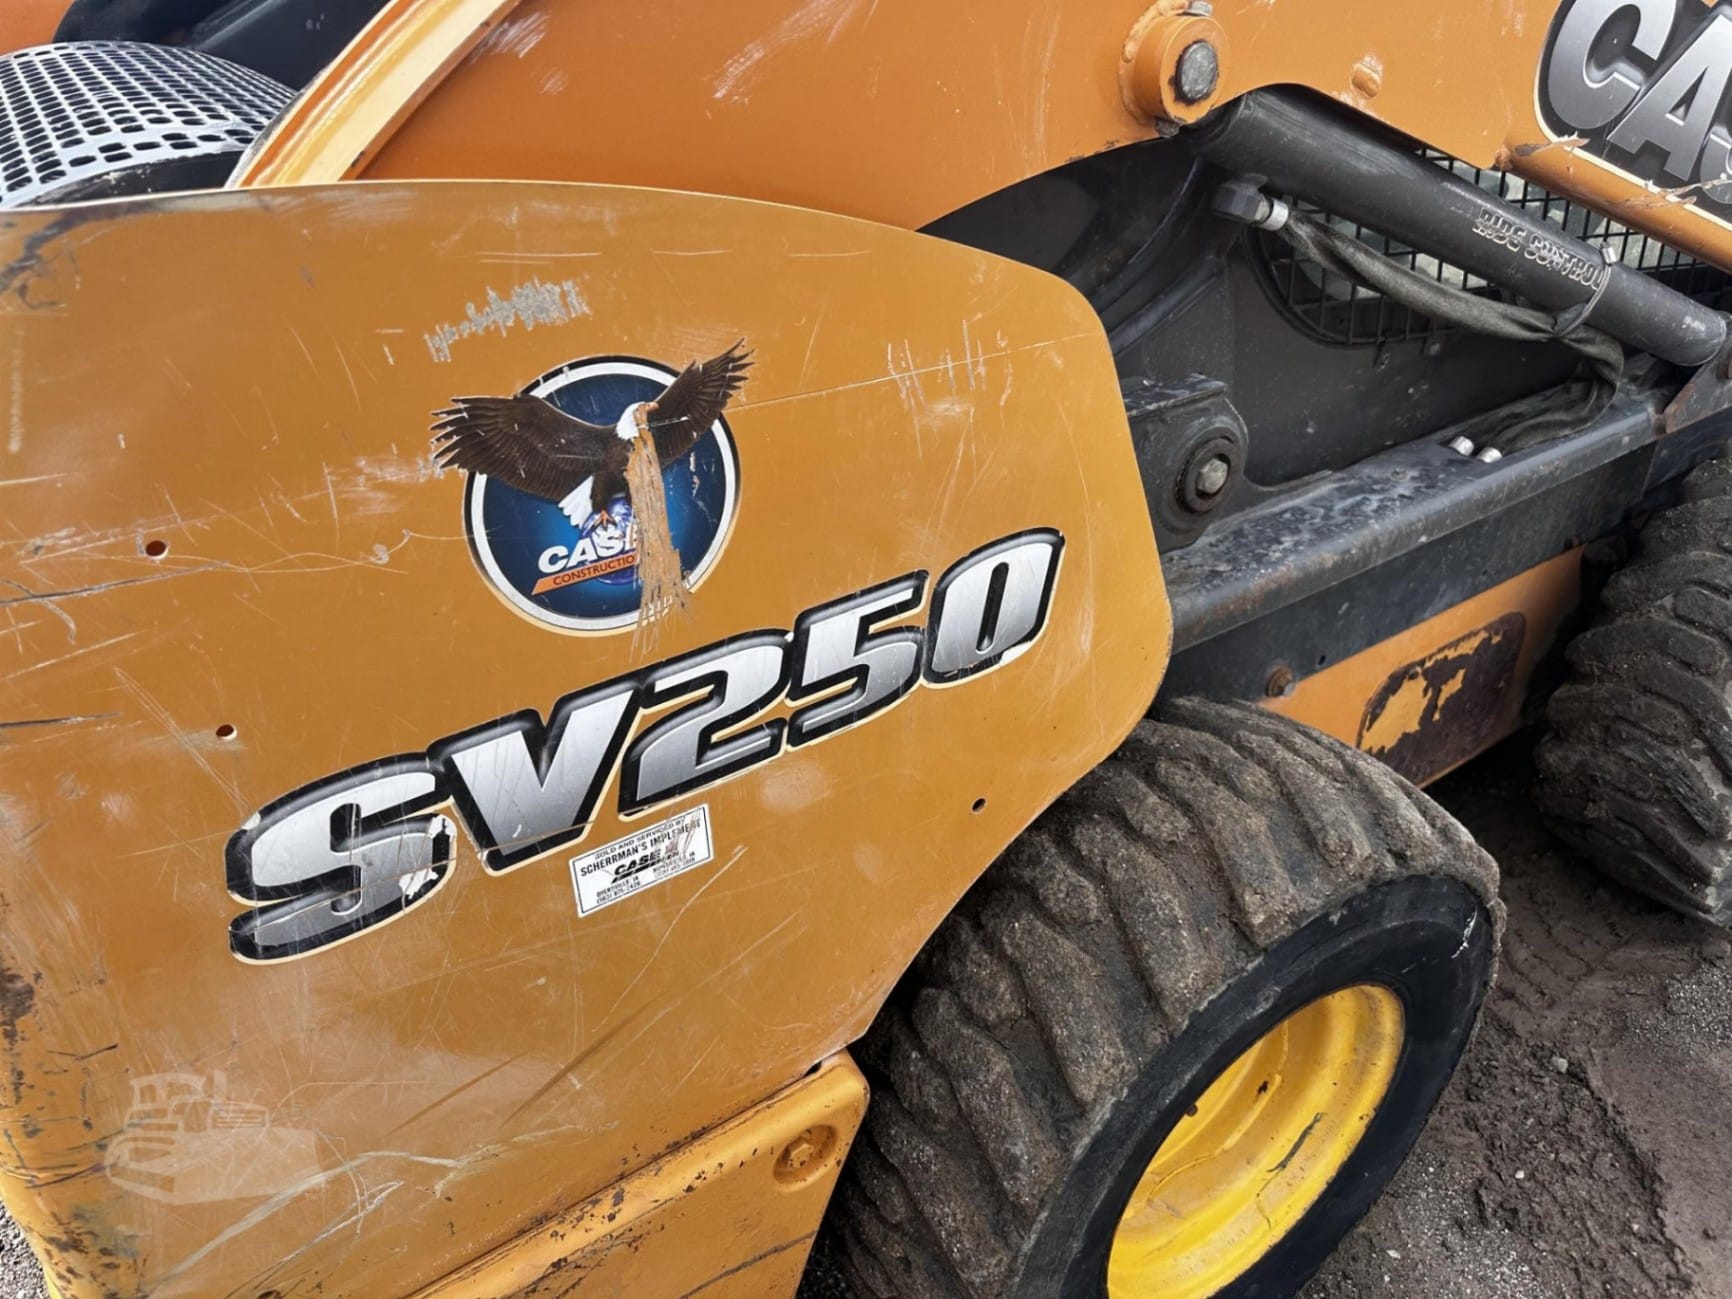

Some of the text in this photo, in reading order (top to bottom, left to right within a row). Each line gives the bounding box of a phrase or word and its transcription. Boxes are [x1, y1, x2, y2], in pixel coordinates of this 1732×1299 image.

[1472, 207, 1527, 252] RIDE
[552, 554, 636, 586] CONSTRUCTIO
[226, 528, 1064, 963] SV250
[580, 841, 648, 877] SCHERRMAN'S
[594, 846, 617, 860] SOLD
[618, 839, 636, 850] AND
[614, 849, 661, 876] CASE
